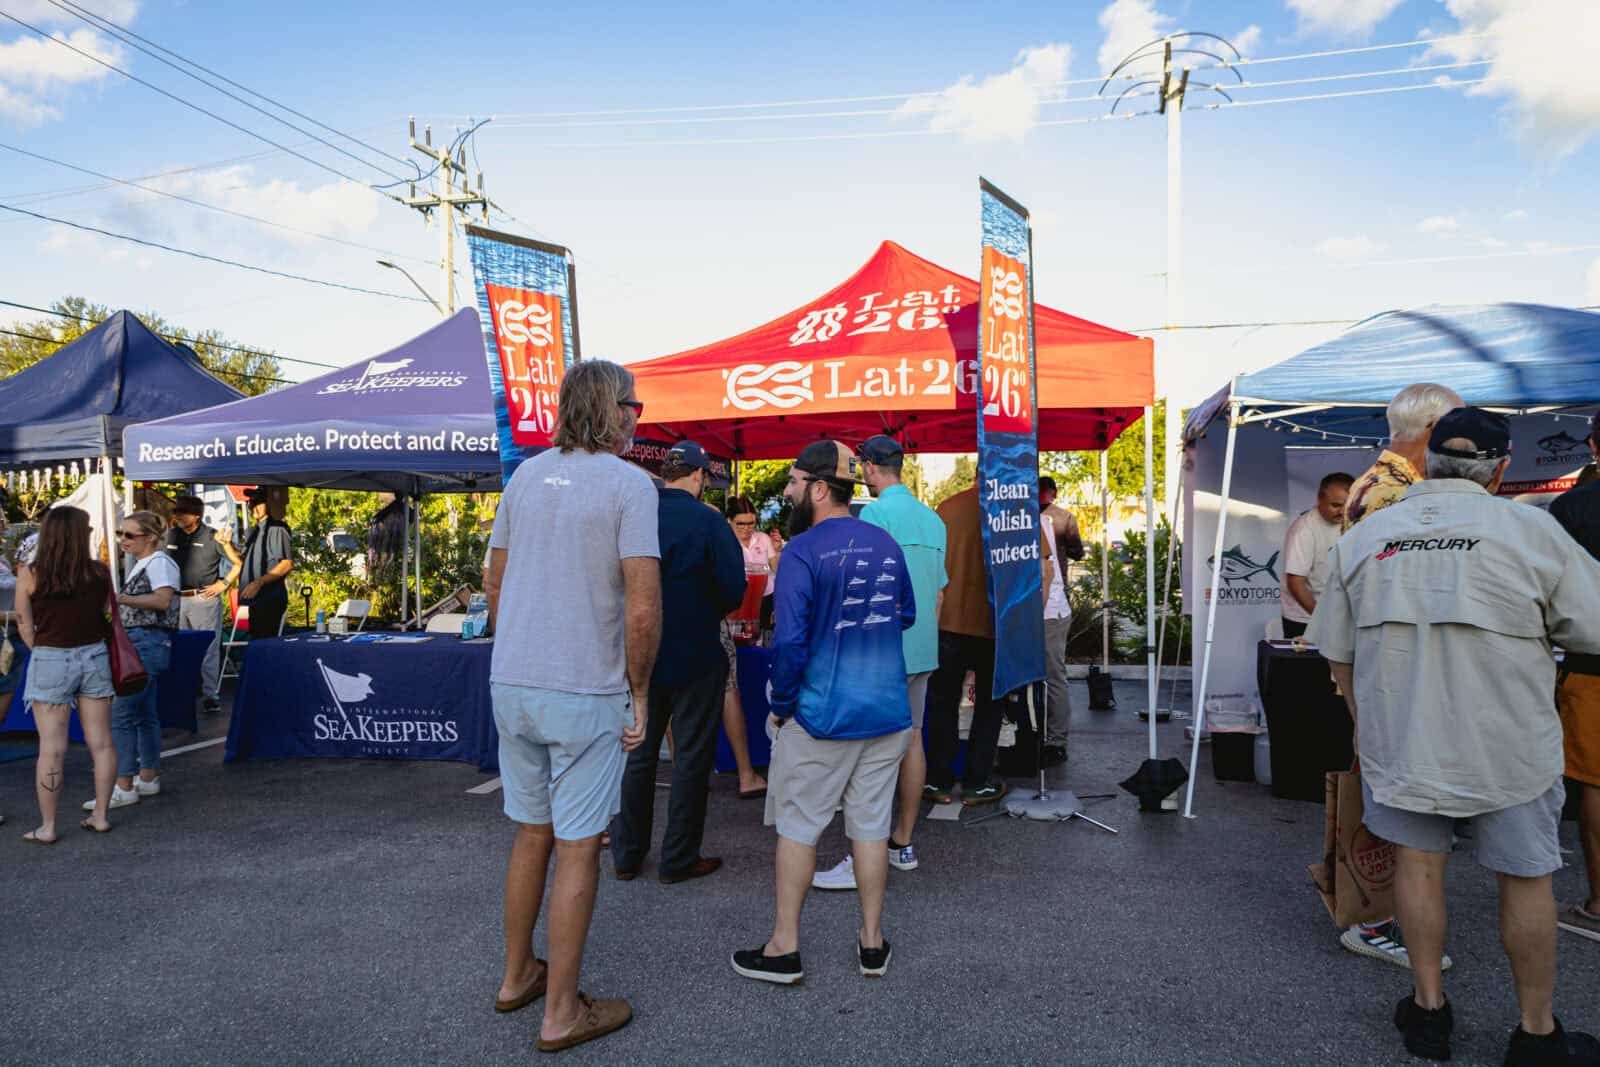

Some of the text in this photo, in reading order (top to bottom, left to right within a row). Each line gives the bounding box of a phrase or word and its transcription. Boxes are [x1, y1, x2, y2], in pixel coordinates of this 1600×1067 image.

[855, 284, 960, 314] Lat
[986, 317, 1025, 364] Lat
[502, 345, 557, 385] Lat
[824, 357, 915, 398] Lat
[139, 429, 499, 462] Research. Educate. Protect and Rest
[990, 540, 1040, 565] rotect
[1384, 539, 1480, 552] MERCURY
